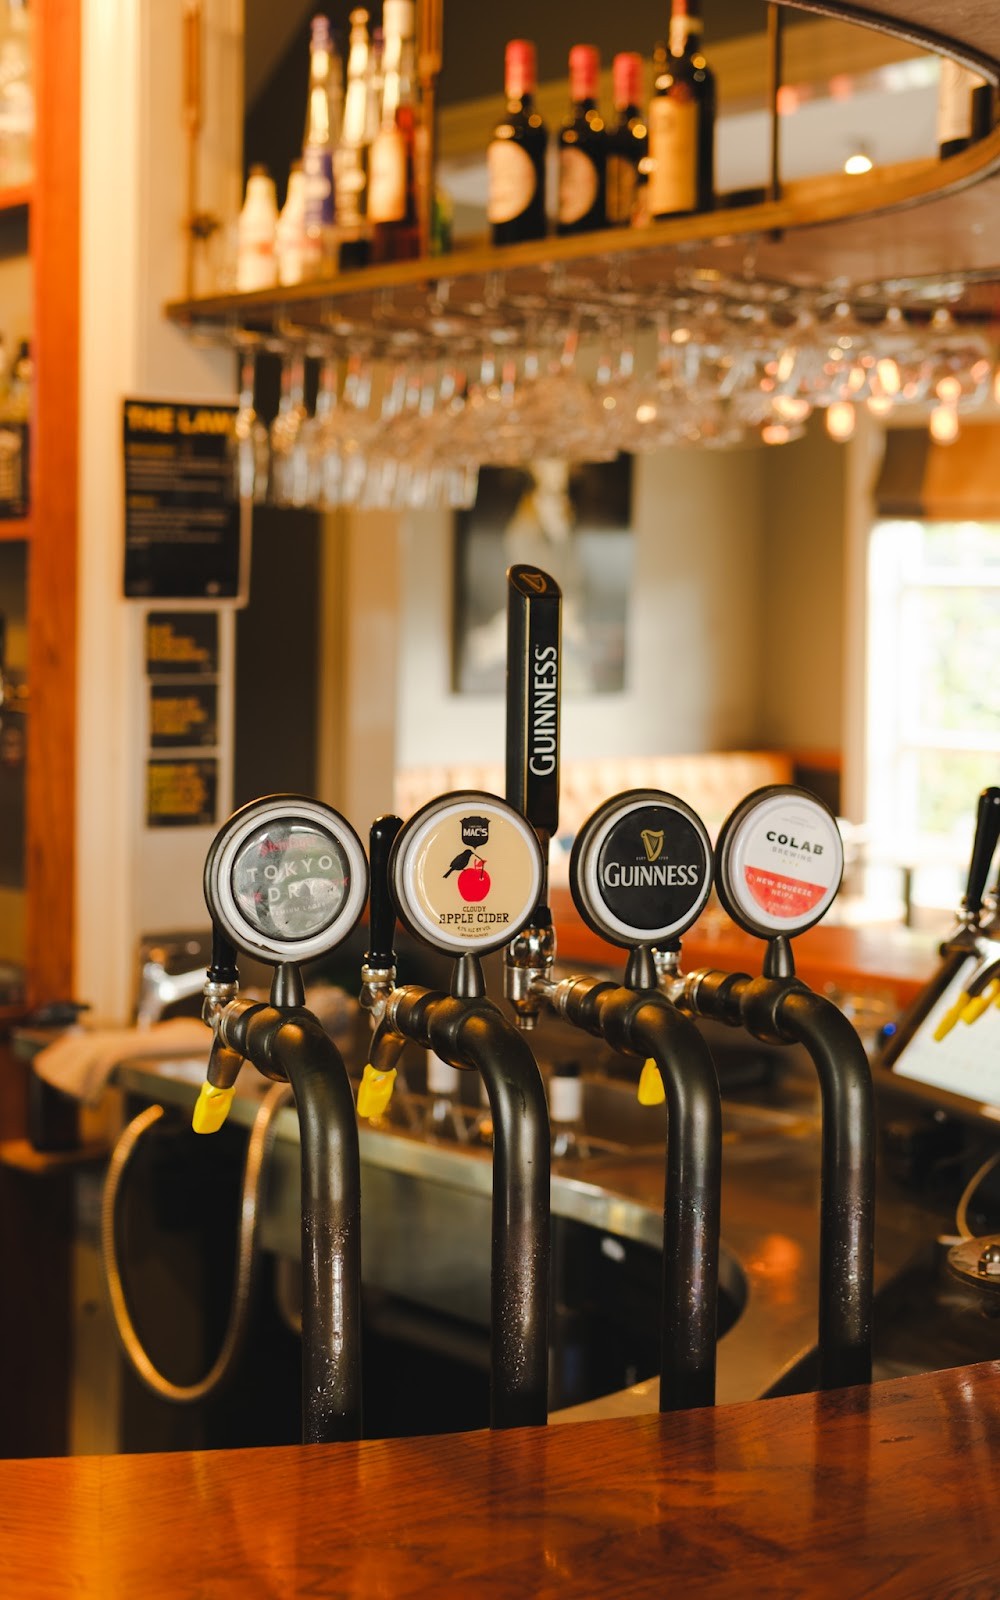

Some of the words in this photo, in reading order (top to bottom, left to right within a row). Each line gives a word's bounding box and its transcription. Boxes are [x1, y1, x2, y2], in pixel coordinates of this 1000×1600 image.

[529, 646, 557, 776] GUINNESS
[463, 827, 488, 837] MAC'S
[766, 831, 824, 855] COLAB
[772, 846, 812, 862] BREWING
[246, 855, 333, 883] TOKYO
[604, 862, 699, 887] GUINNESS
[268, 880, 317, 902] DRY
[756, 876, 775, 886] NEW
[776, 883, 813, 897] SQUEEZE
[439, 913, 473, 924] APPLE
[477, 913, 509, 923] CIDER
